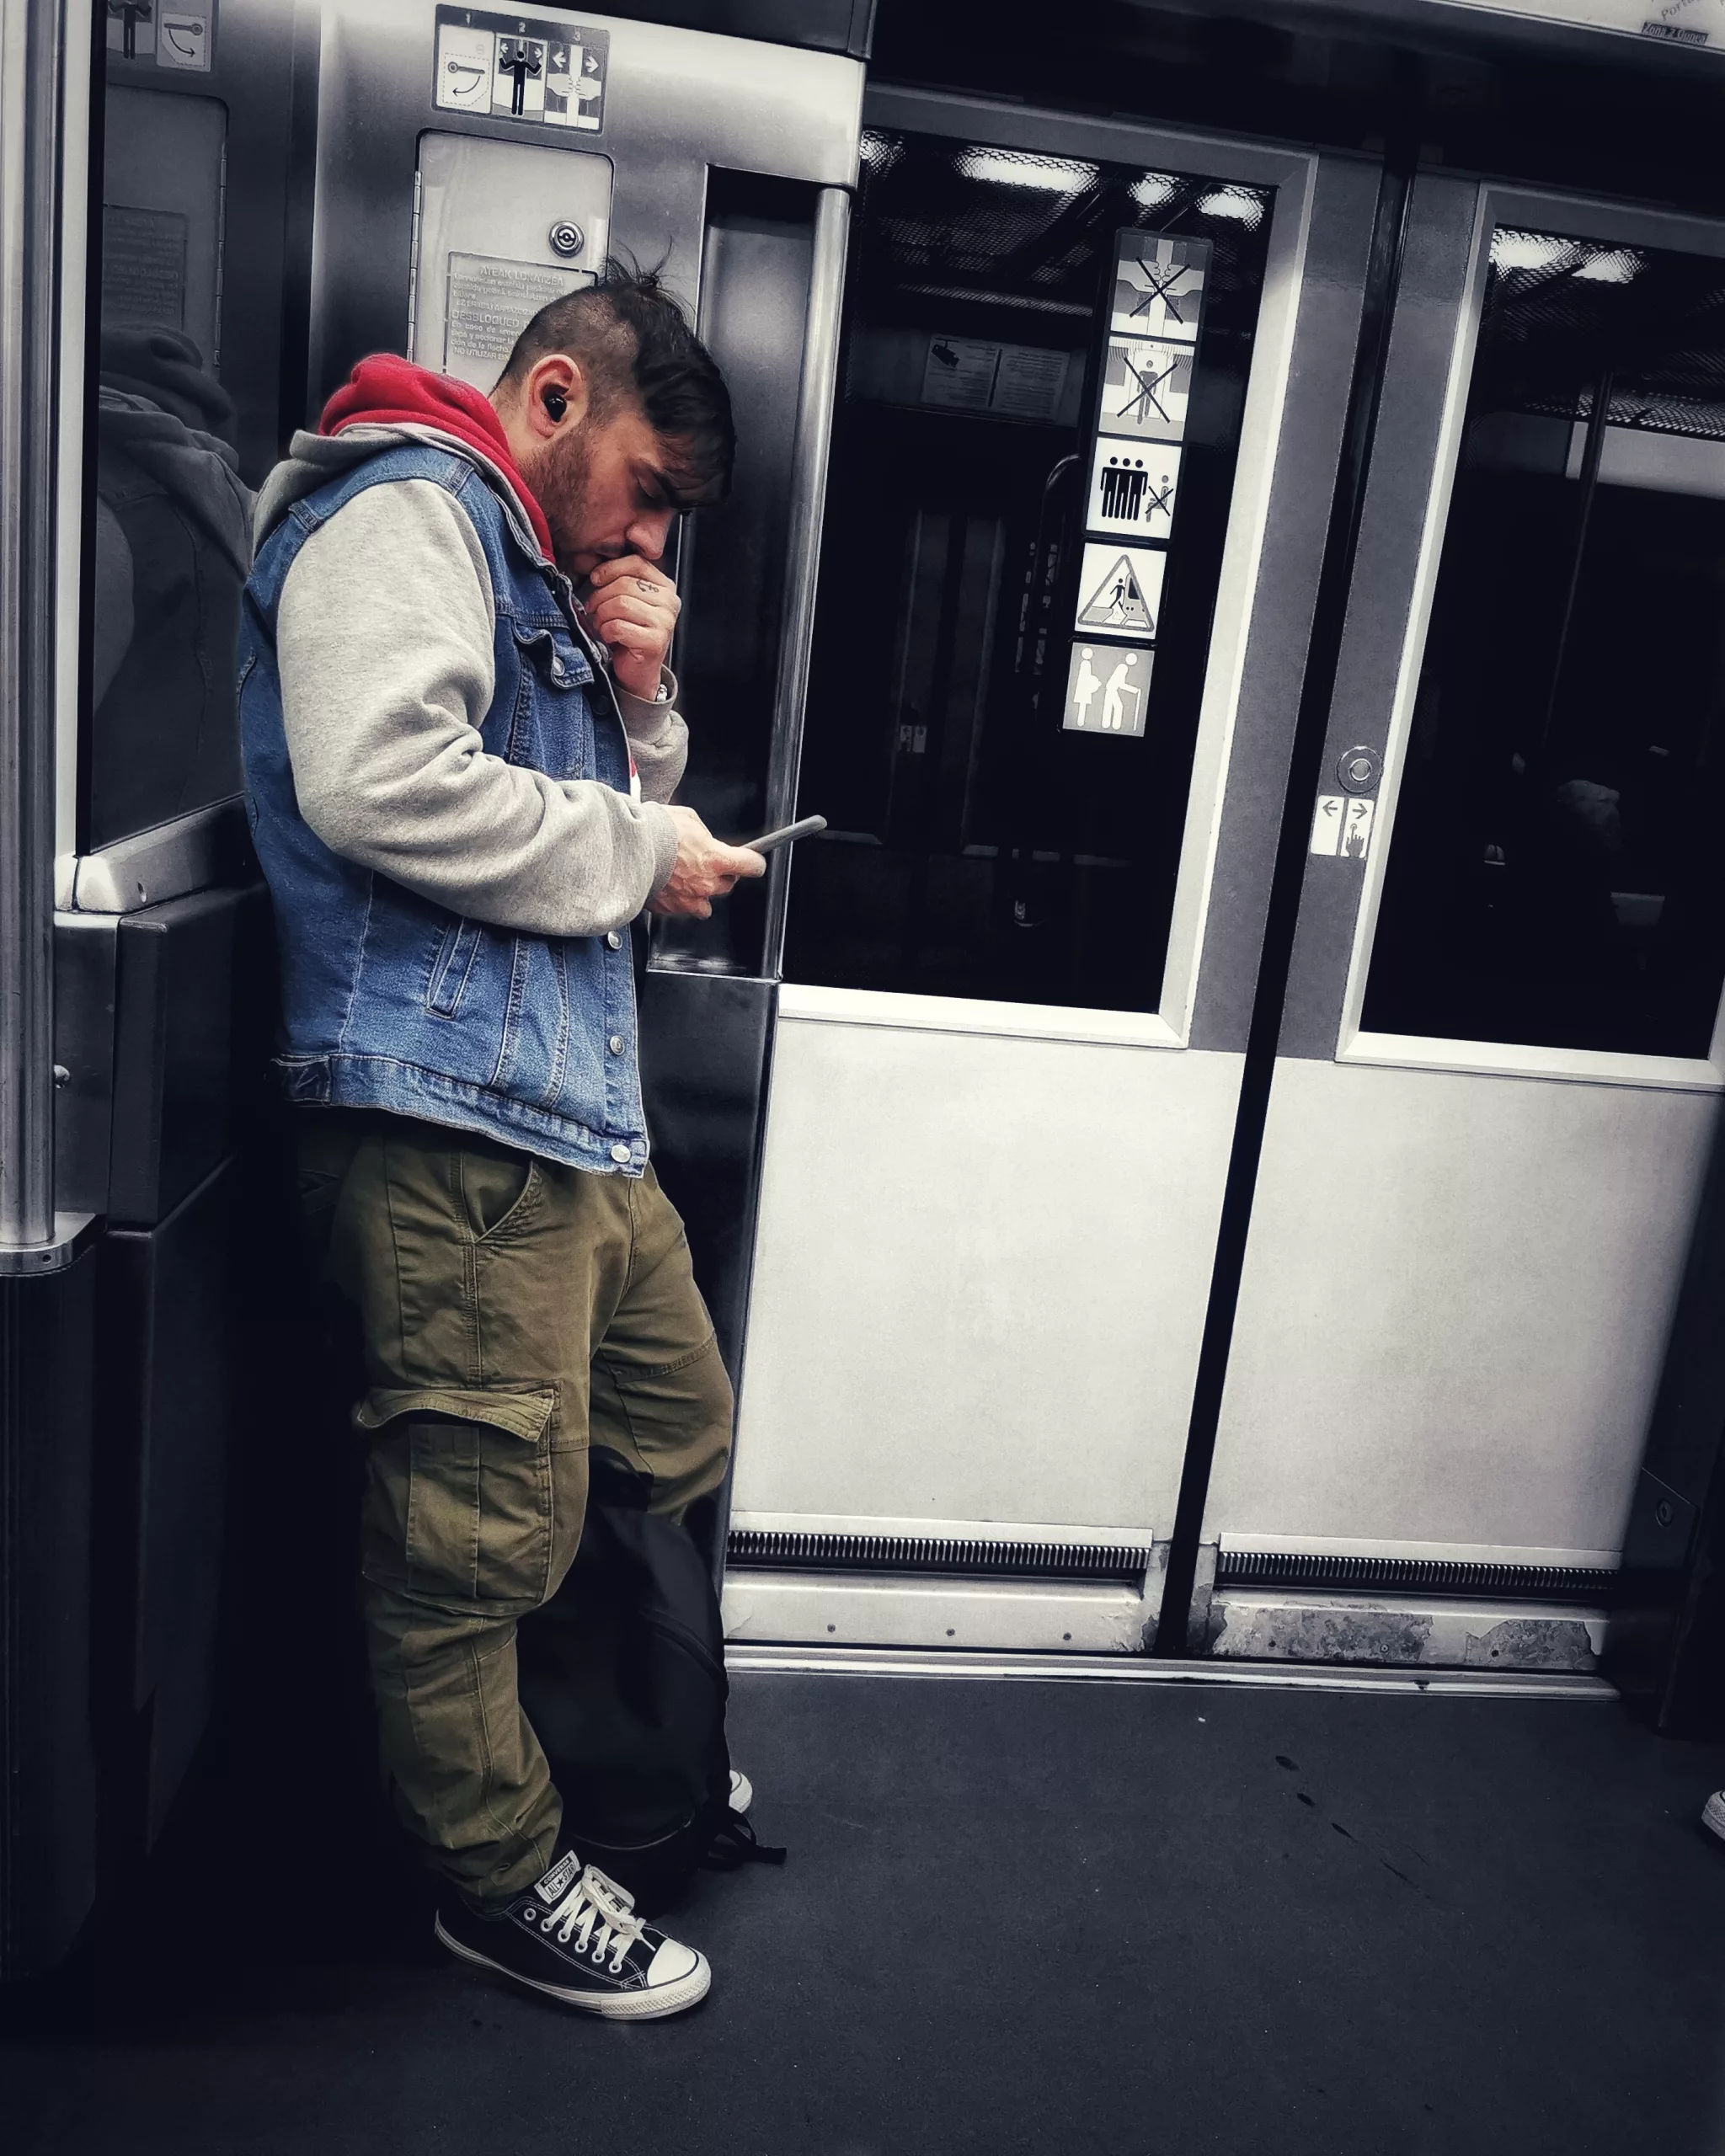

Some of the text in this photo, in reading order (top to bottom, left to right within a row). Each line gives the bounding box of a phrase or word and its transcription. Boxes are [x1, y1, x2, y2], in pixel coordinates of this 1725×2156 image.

[465, 12, 581, 42] 1 2 3
[451, 309, 520, 327] DESBLOQUEO
[542, 1858, 571, 1885] CONVERSE
[547, 1881, 561, 1897] ALL
